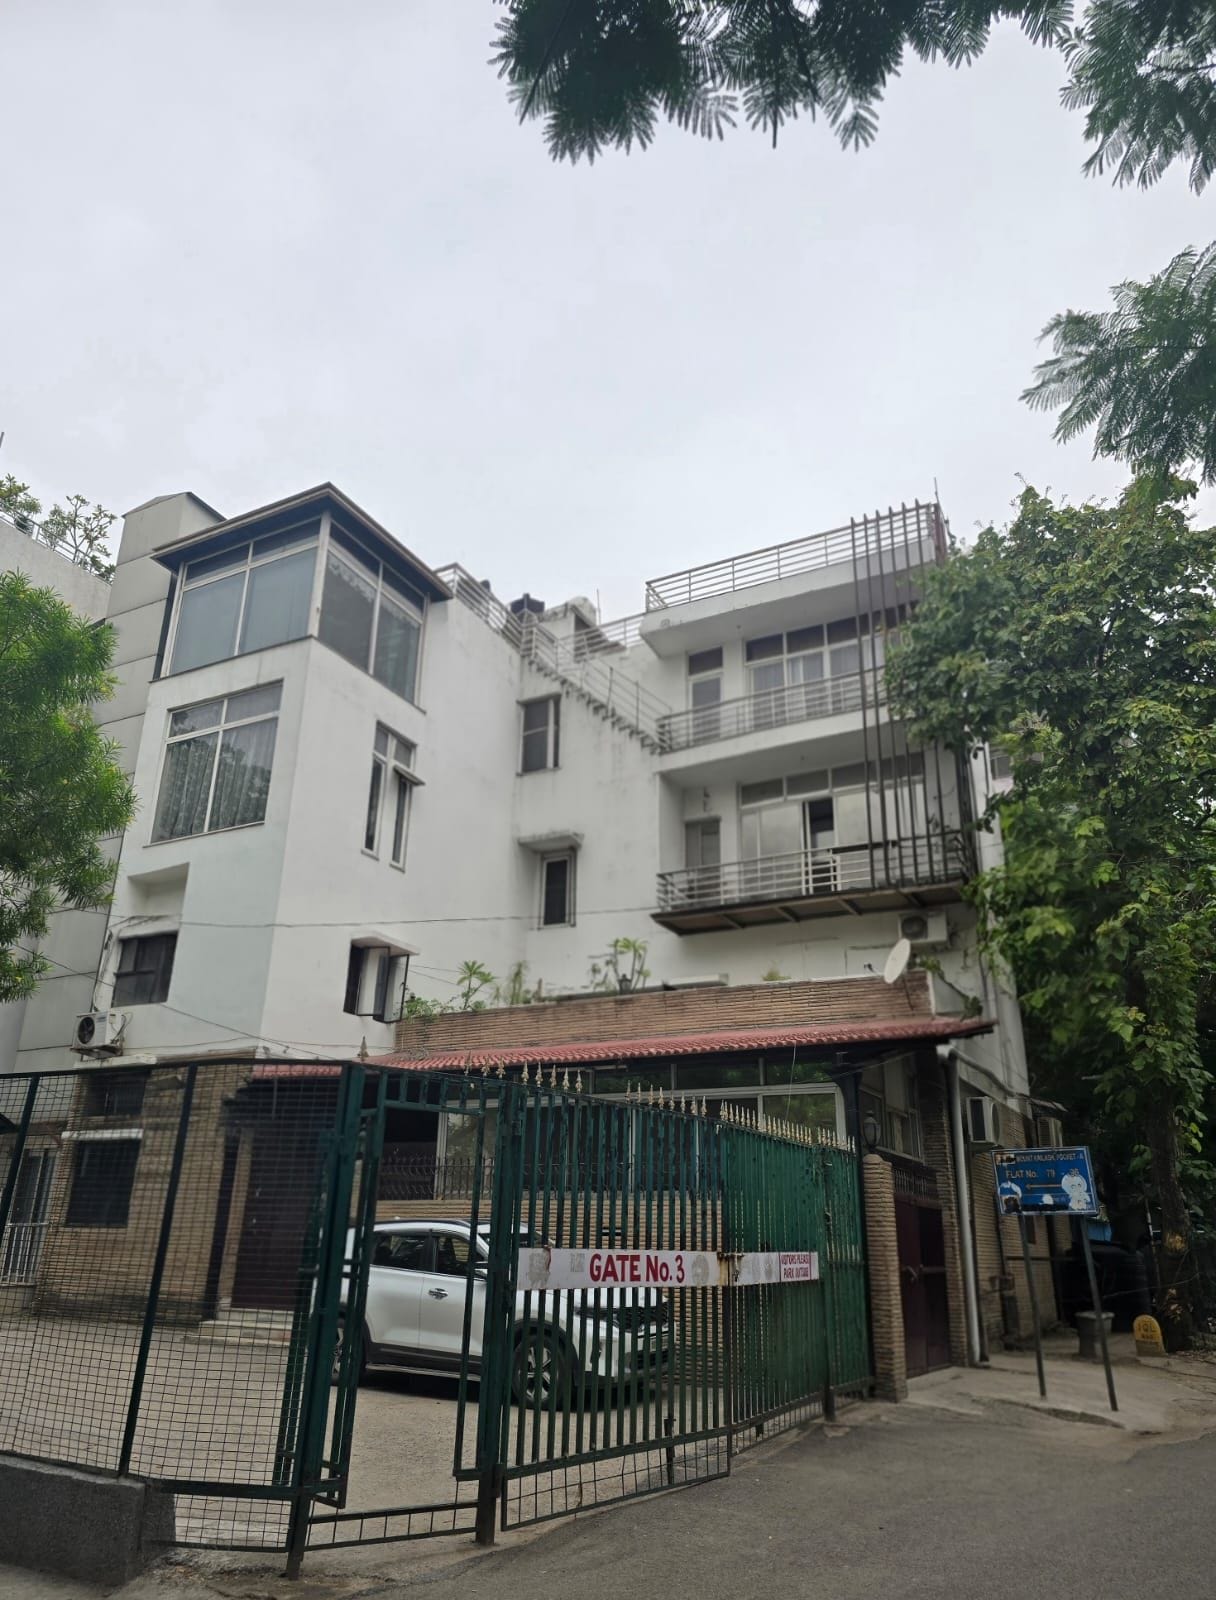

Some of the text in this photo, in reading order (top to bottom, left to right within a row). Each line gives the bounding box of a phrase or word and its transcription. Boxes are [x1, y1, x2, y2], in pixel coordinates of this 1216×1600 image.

[1006, 1169, 1024, 1178] FLAT
[590, 1254, 685, 1283] GATE No. 3
[784, 1267, 794, 1278] PARK
